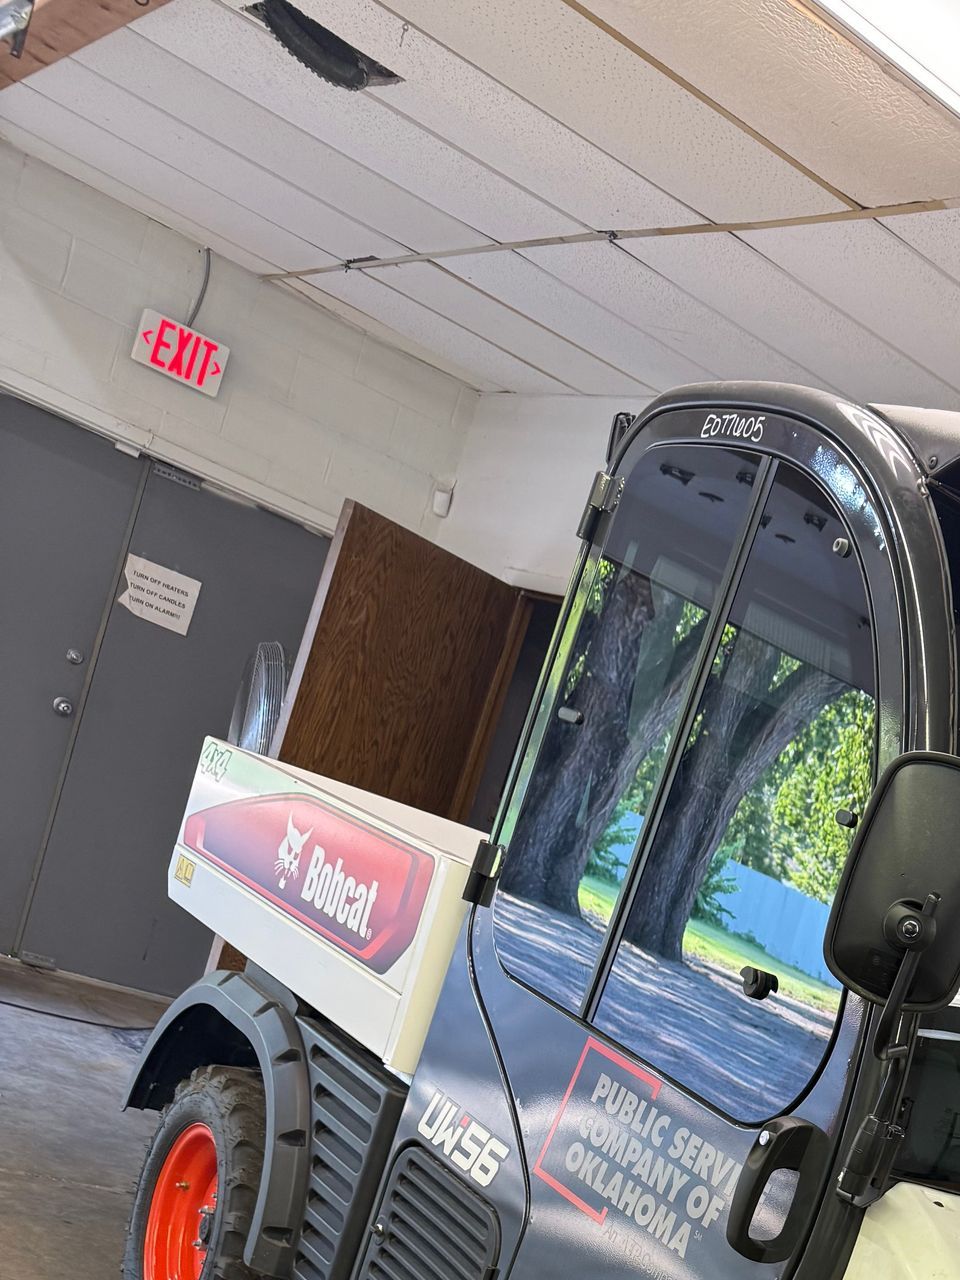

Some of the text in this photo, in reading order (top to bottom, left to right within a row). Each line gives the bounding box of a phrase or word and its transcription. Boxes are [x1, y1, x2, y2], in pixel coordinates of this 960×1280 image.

[150, 319, 219, 387] EXIT
[128, 594, 145, 606] TURN
[144, 601, 154, 609] ON
[129, 581, 186, 609] TURN OFF CANDLES
[133, 570, 189, 598] TURN OFF HEATERS
[300, 844, 379, 939] Bobcat
[578, 1110, 727, 1229] COMPANY OF
[590, 1072, 755, 1202] PUBLIC SERVI
[565, 1141, 693, 1259] OKLAHOMA
